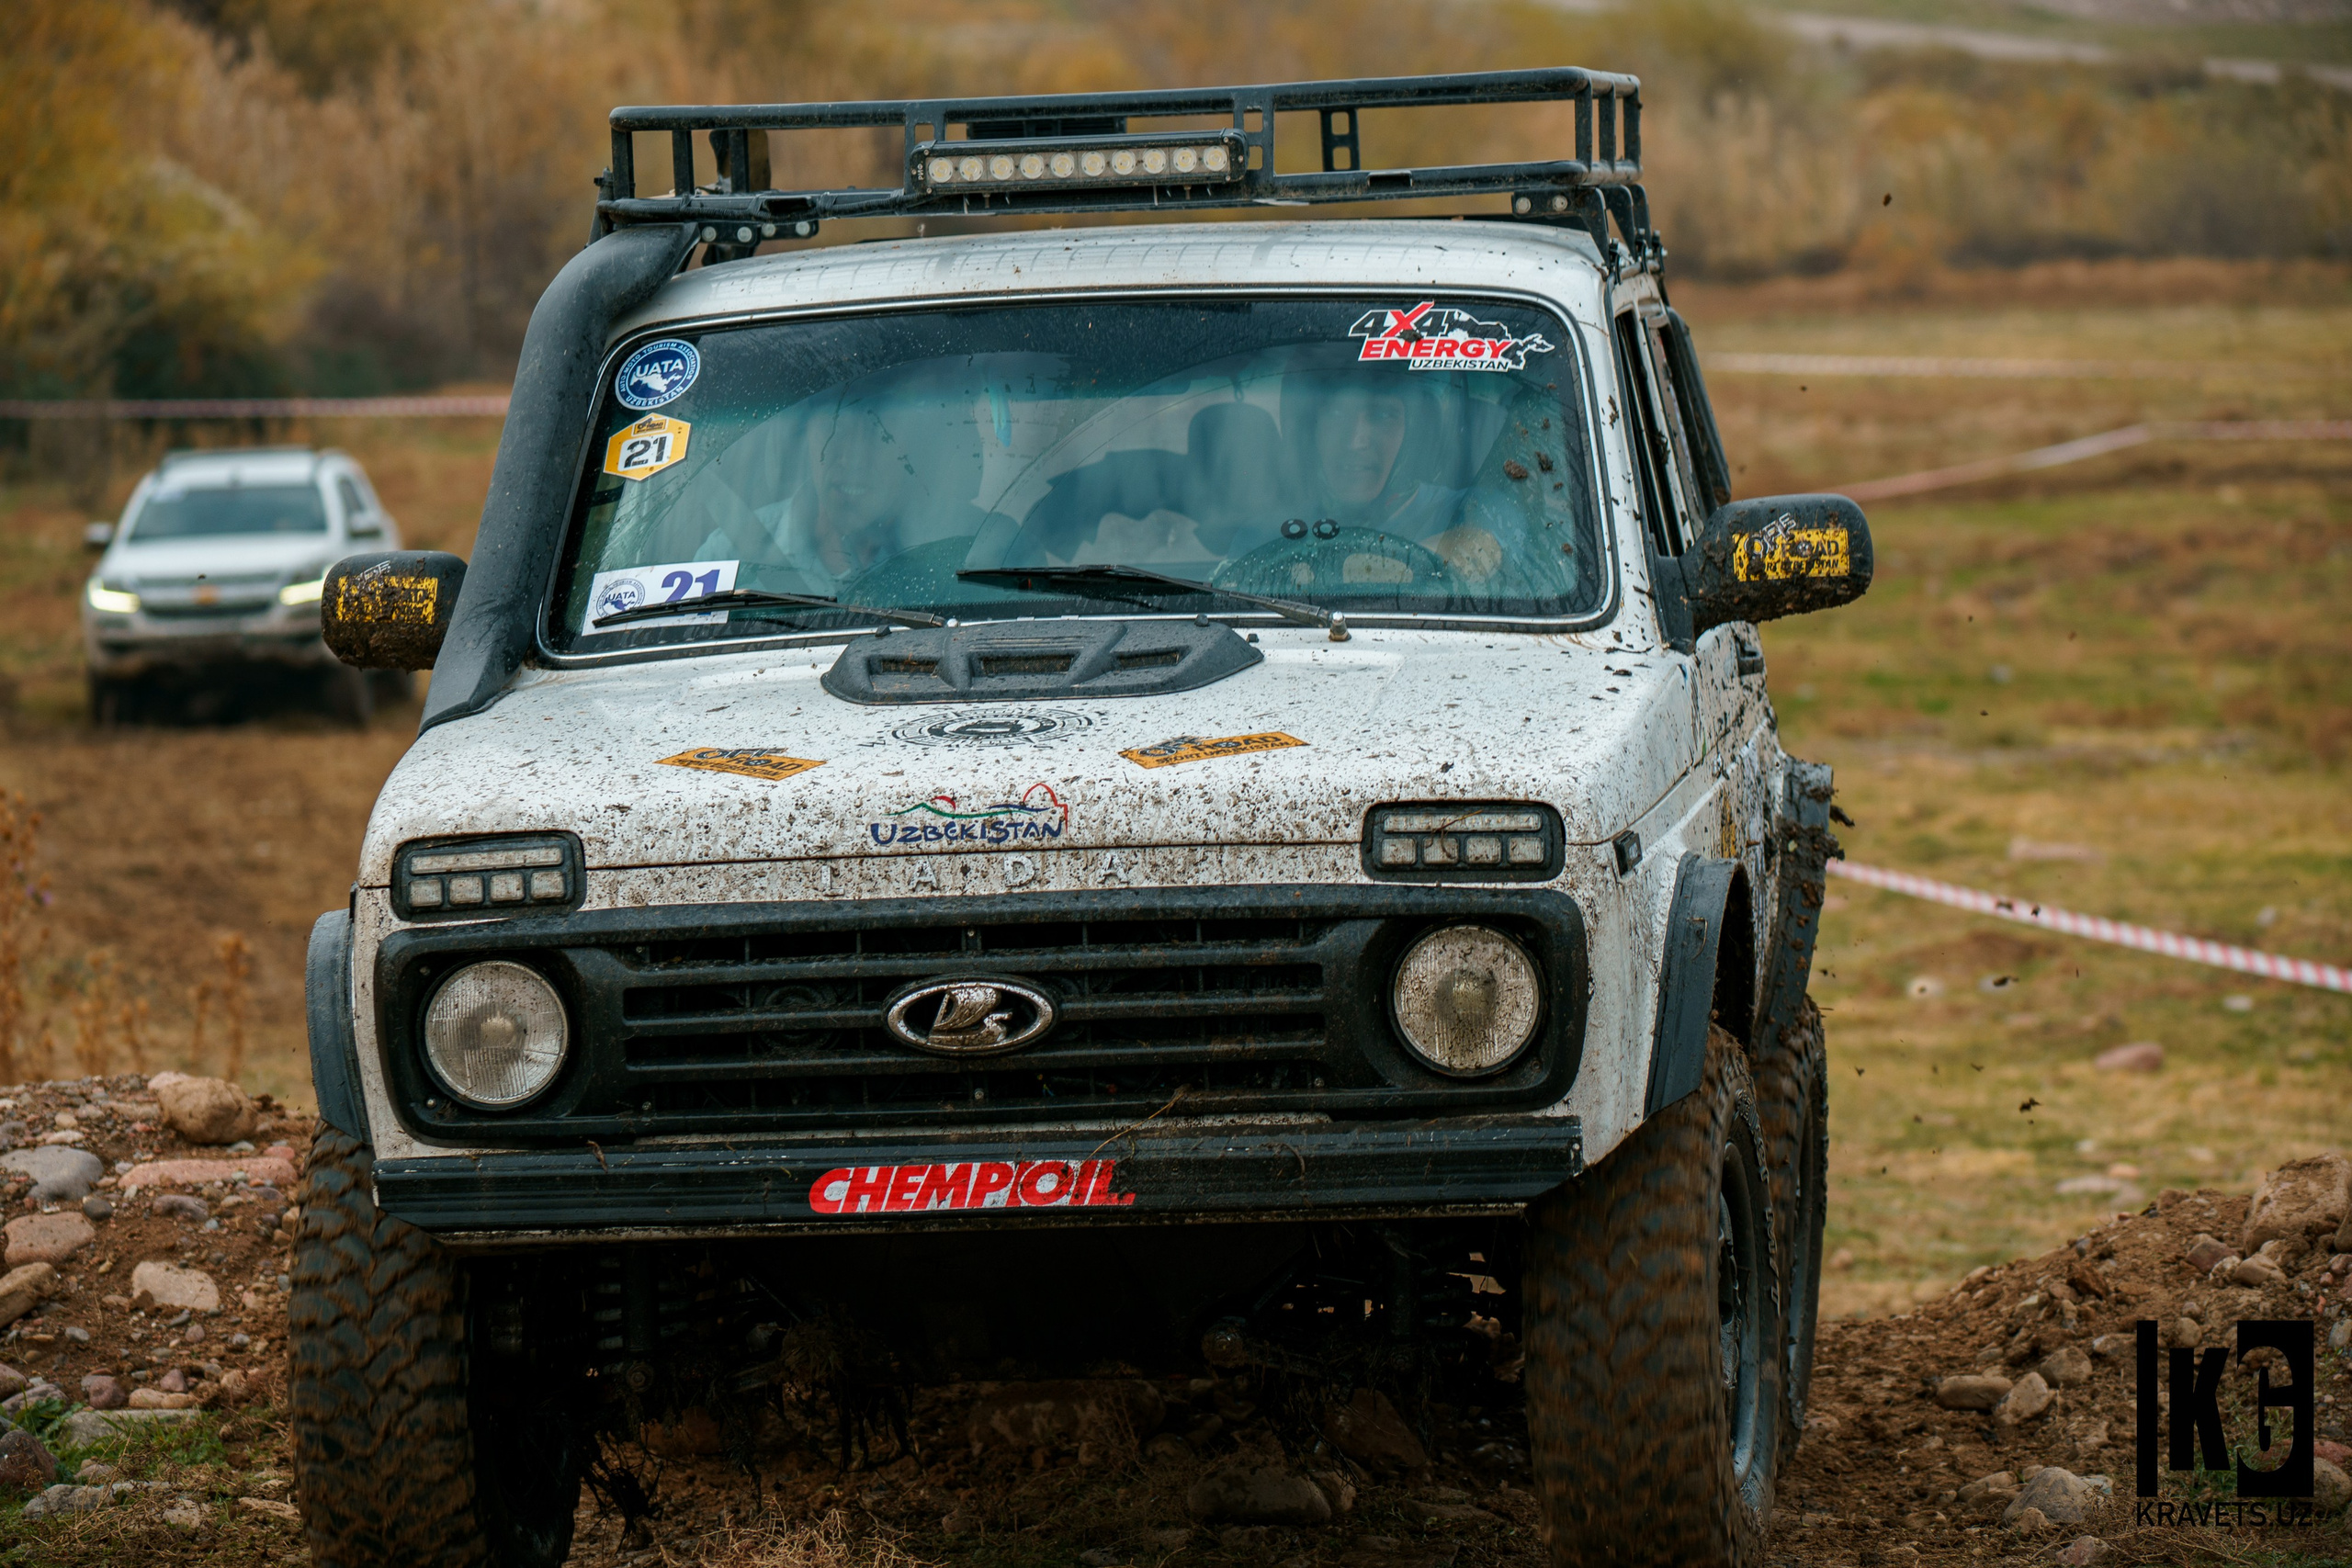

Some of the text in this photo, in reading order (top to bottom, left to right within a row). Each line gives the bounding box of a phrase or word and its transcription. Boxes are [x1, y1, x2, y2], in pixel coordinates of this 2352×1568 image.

[1361, 339, 1513, 359] ENERGY
[636, 358, 684, 378] UATA
[642, 343, 677, 355] TOURISM
[678, 344, 696, 380] ASSOCIATION
[1412, 359, 1509, 369] UZBEKISTAN
[626, 386, 684, 406] UZBEKISTAN
[624, 436, 667, 468] 21
[607, 591, 636, 601] UATA
[661, 569, 720, 616] 21
[1155, 752, 1201, 764] SPORT
[870, 820, 1064, 845] UZBEKISTAN
